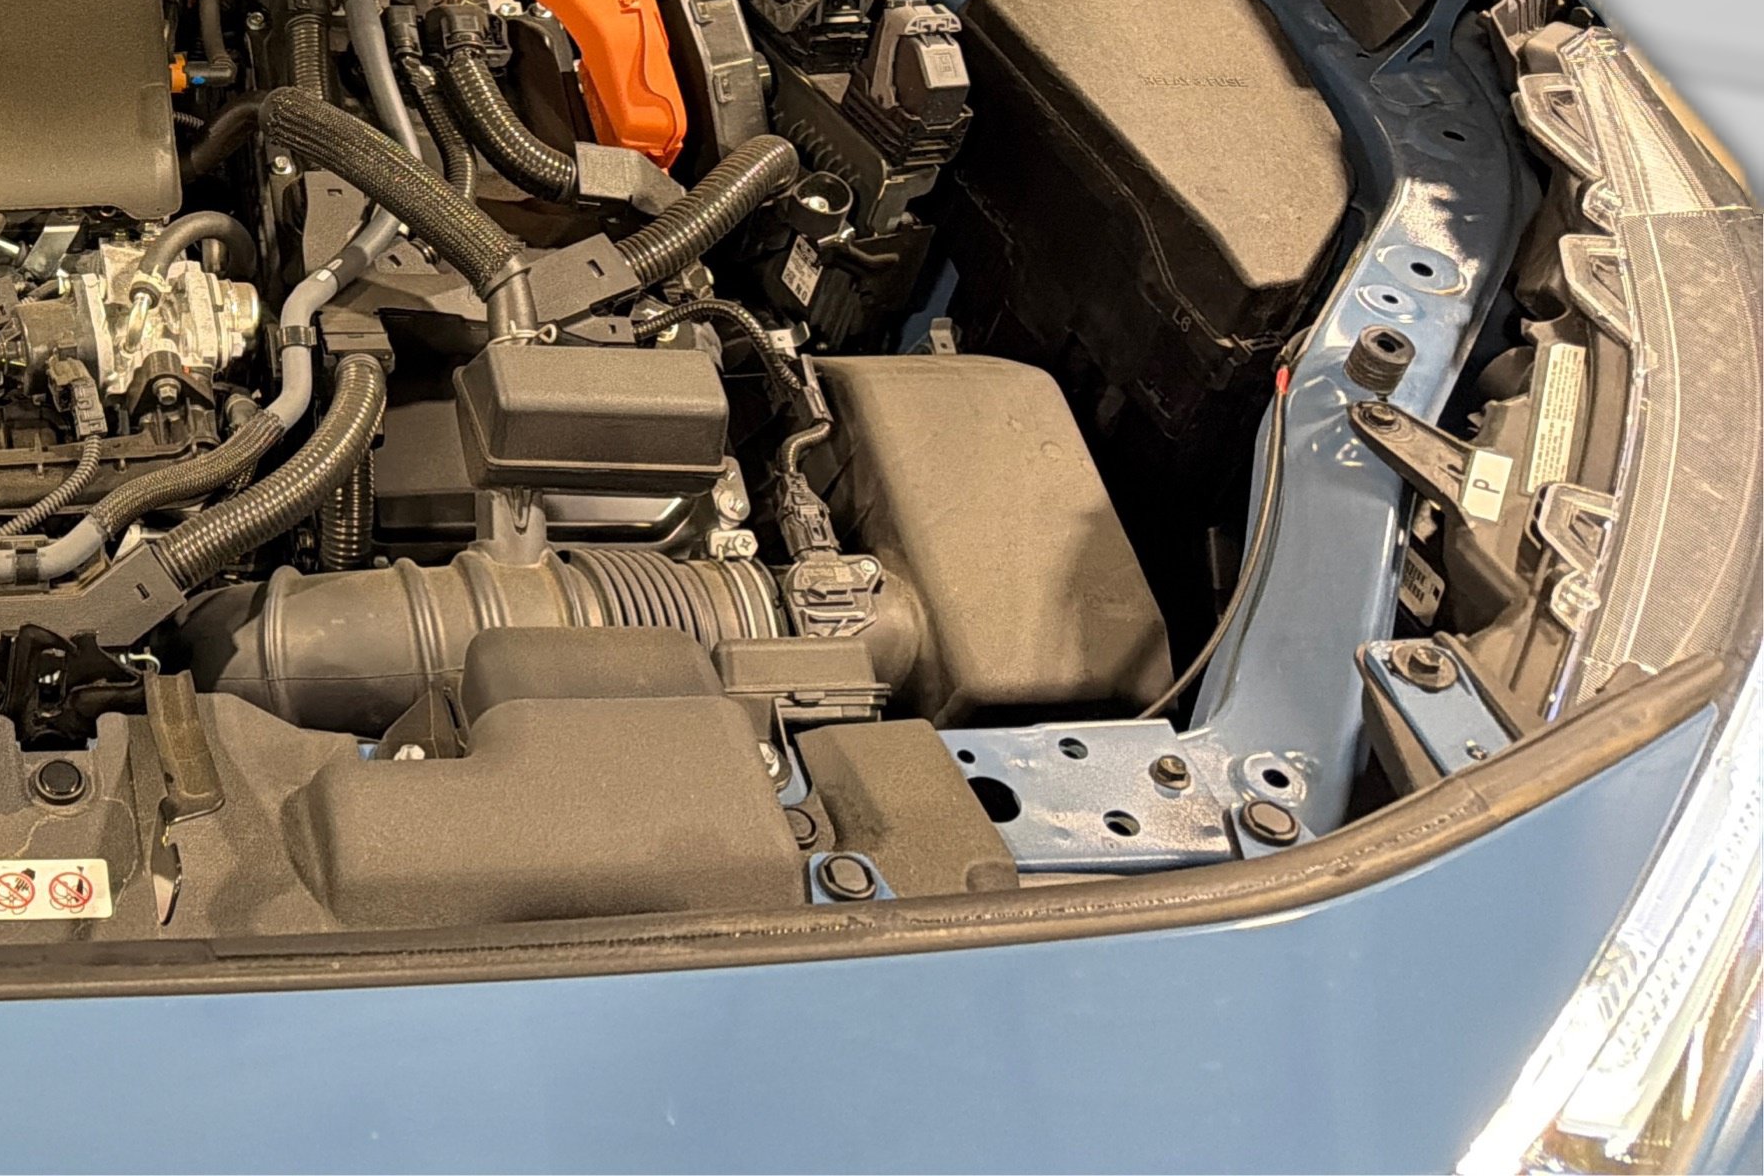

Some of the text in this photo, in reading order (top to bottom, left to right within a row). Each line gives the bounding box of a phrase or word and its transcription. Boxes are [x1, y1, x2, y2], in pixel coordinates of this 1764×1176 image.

[1142, 75, 1190, 87] RELAY
[1204, 76, 1249, 88] FUSE
[1472, 479, 1501, 495] P
